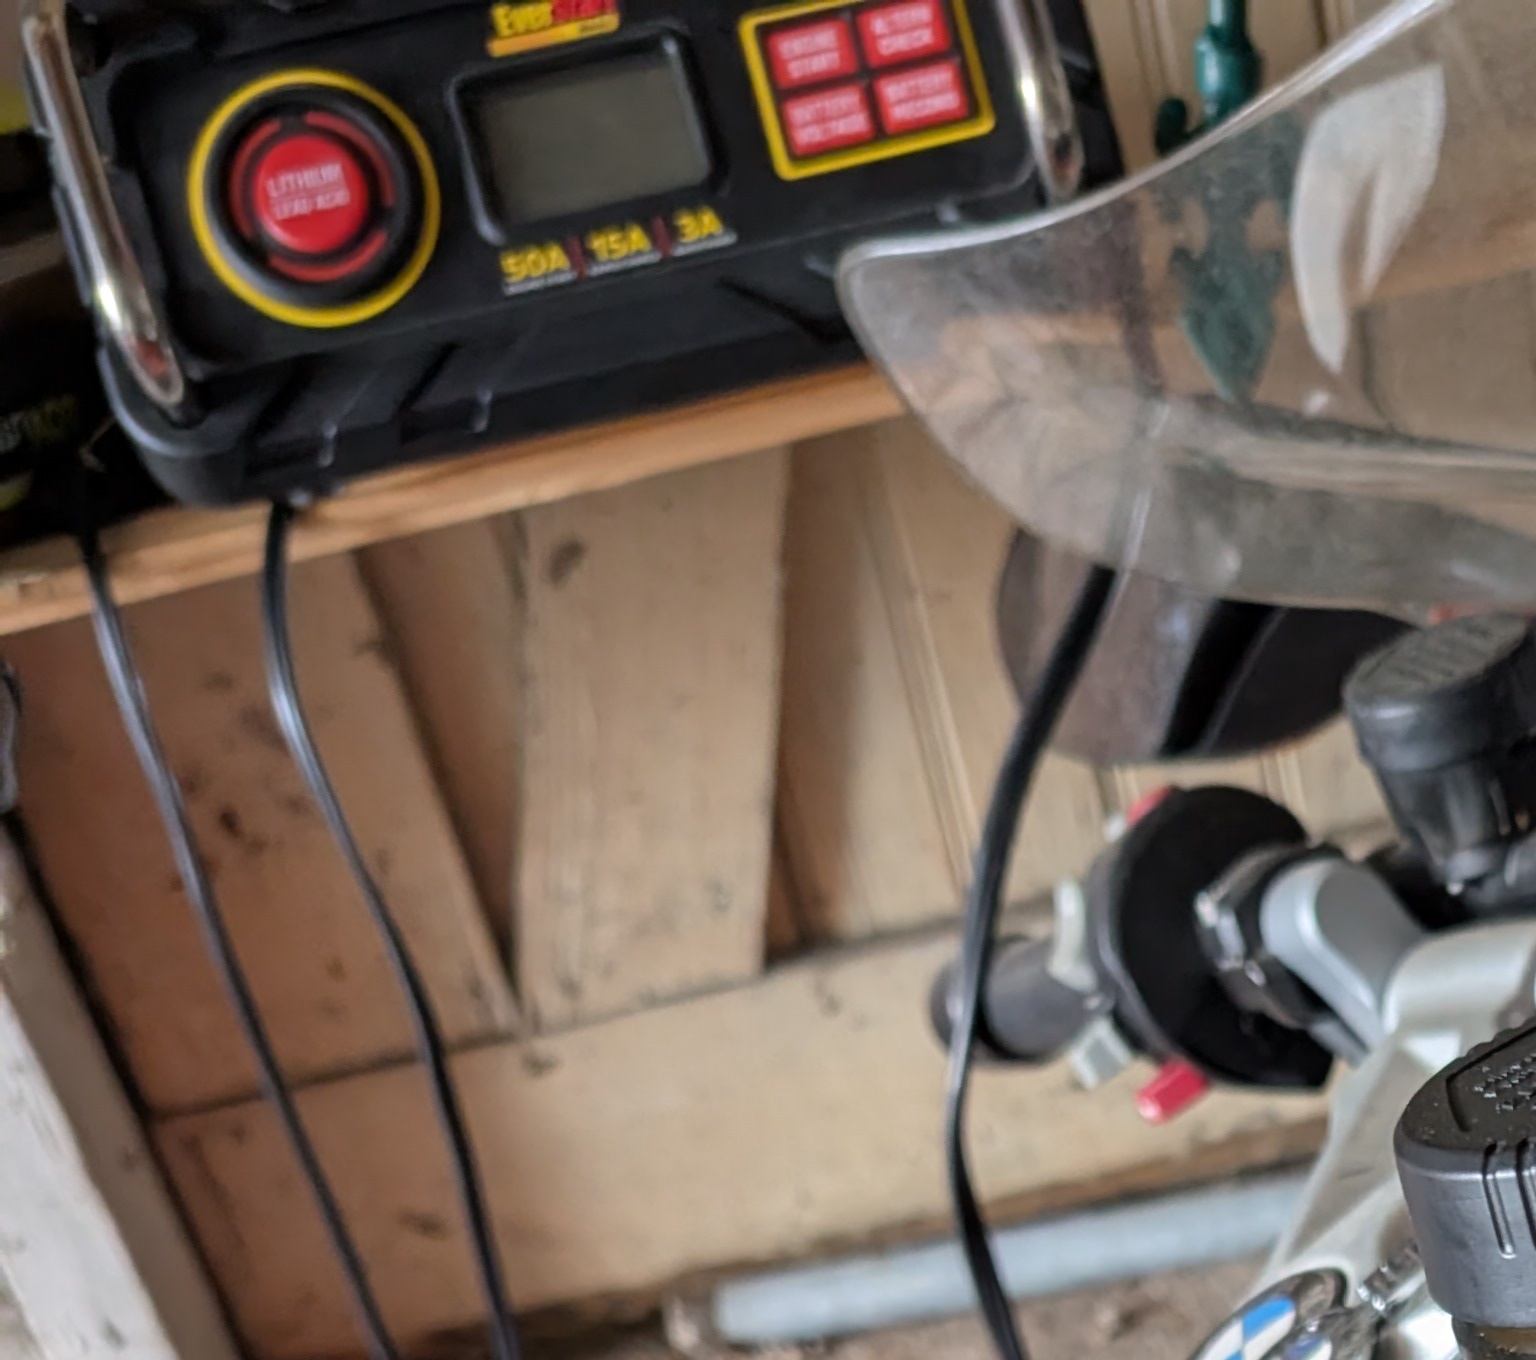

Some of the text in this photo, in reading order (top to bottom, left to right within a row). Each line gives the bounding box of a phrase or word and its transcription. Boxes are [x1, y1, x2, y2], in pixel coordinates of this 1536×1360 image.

[266, 163, 343, 198] LITHIUM
[500, 243, 570, 282] 50A
[587, 225, 651, 262] 15A
[676, 206, 723, 242] 3A
